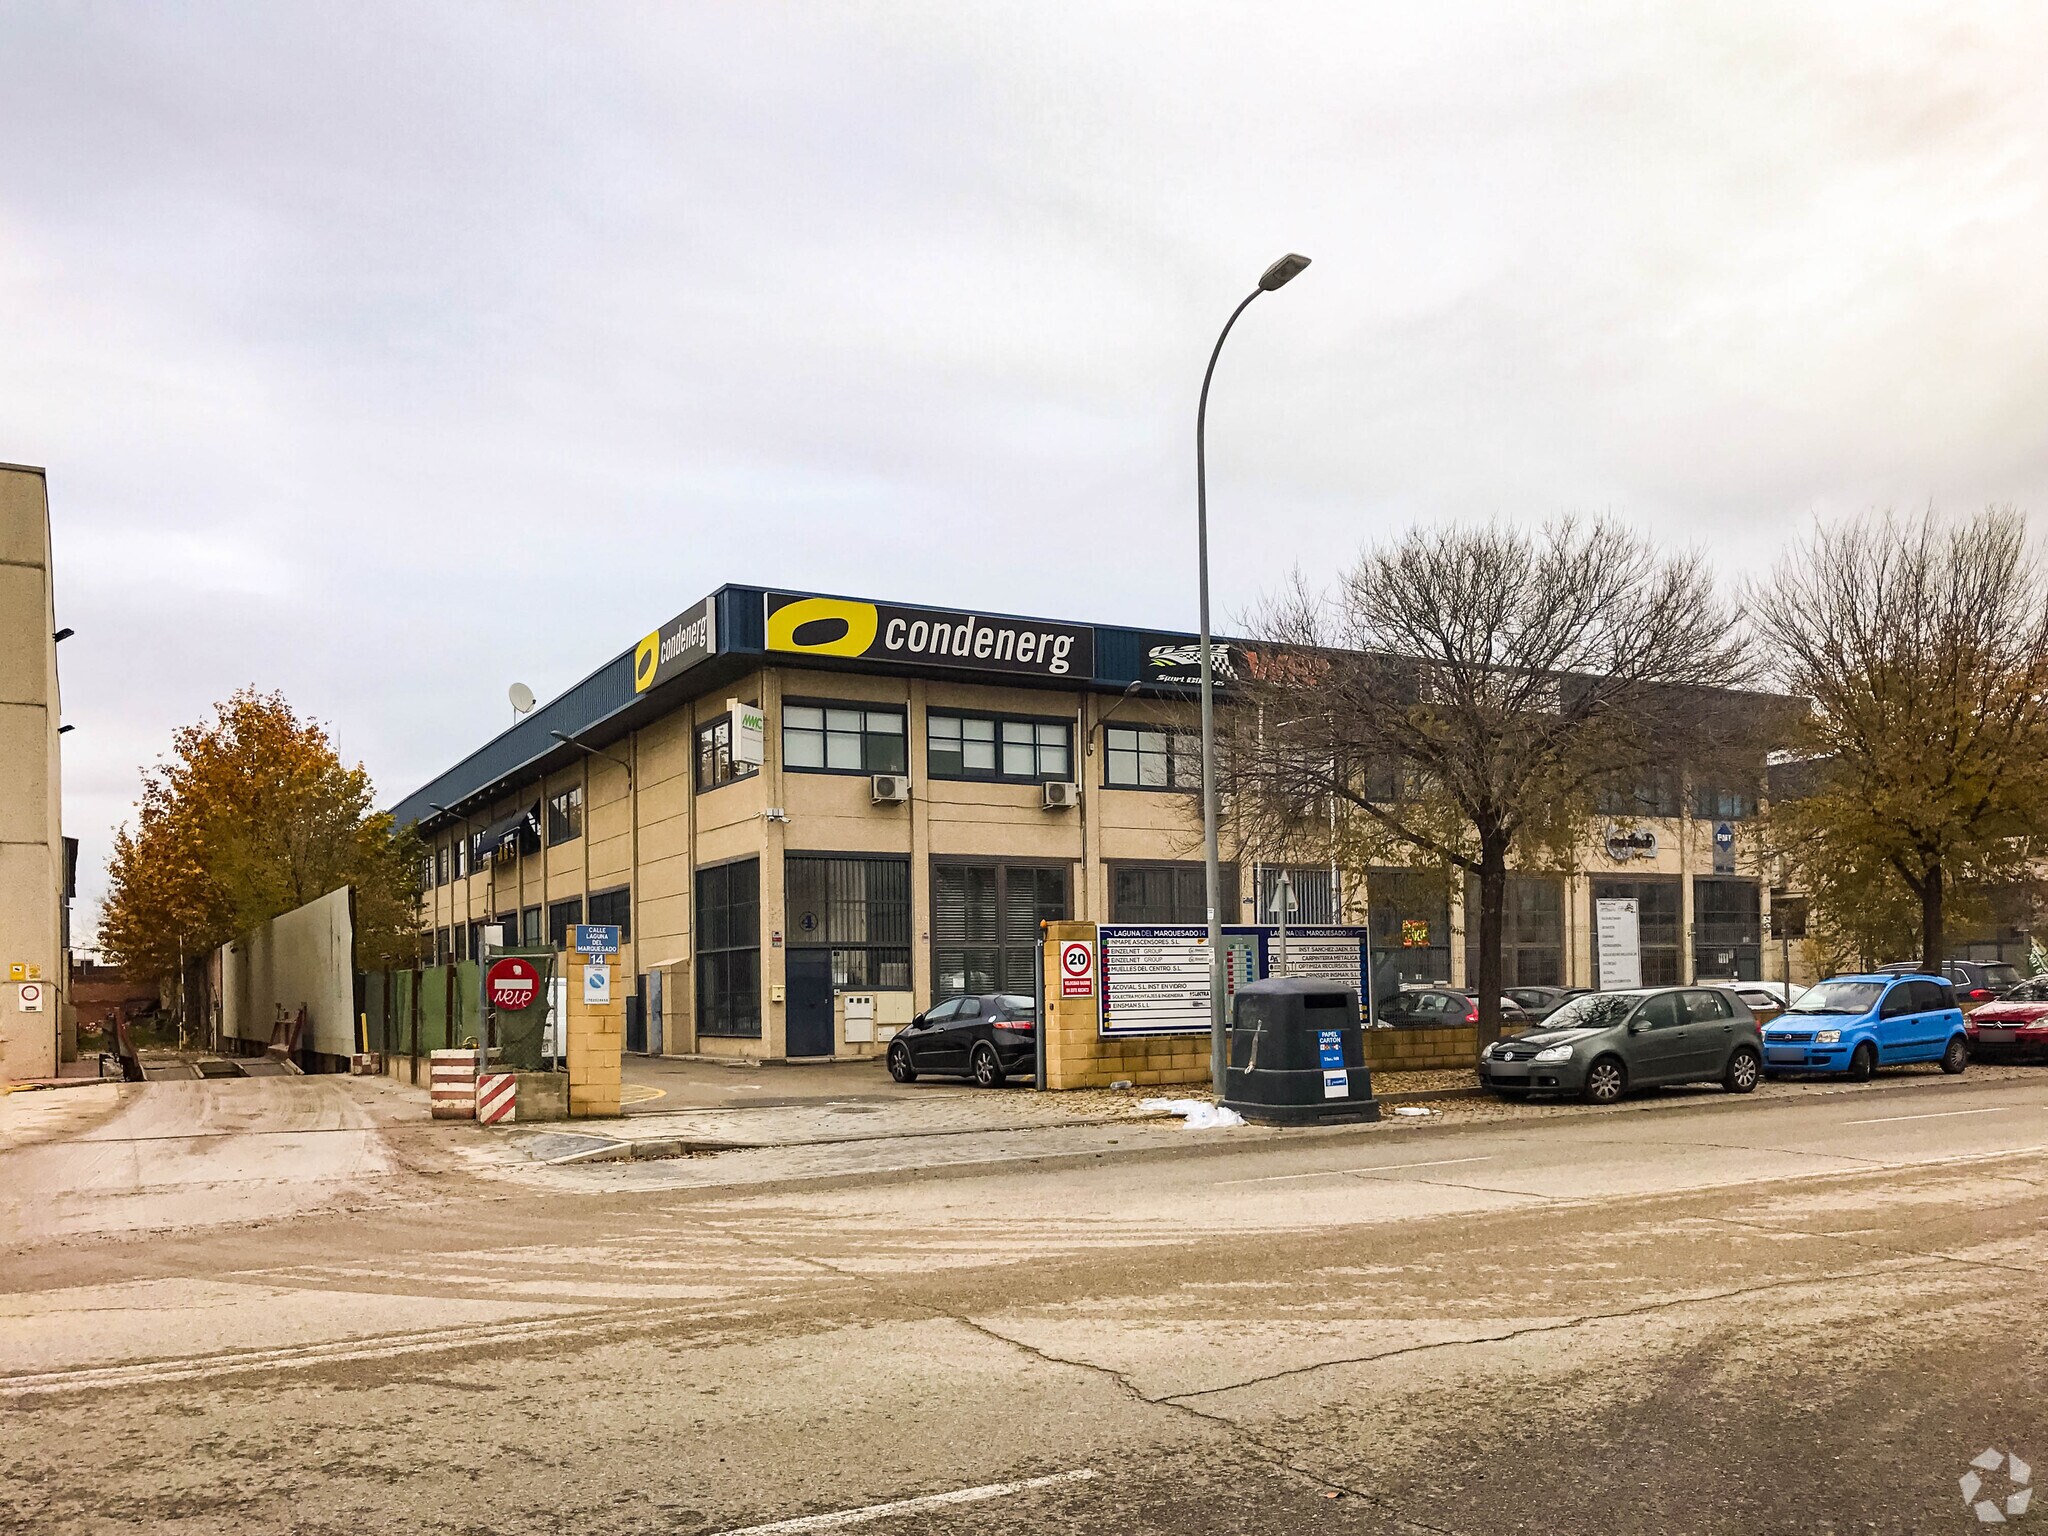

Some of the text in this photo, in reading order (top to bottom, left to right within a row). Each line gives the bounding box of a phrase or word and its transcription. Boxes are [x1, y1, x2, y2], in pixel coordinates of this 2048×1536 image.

[661, 616, 707, 664] condenerg
[885, 616, 1074, 674] condenerg
[1156, 674, 1185, 682] Sport
[802, 914, 813, 929] 4
[590, 954, 604, 965] 14
[1068, 953, 1086, 966] 20
